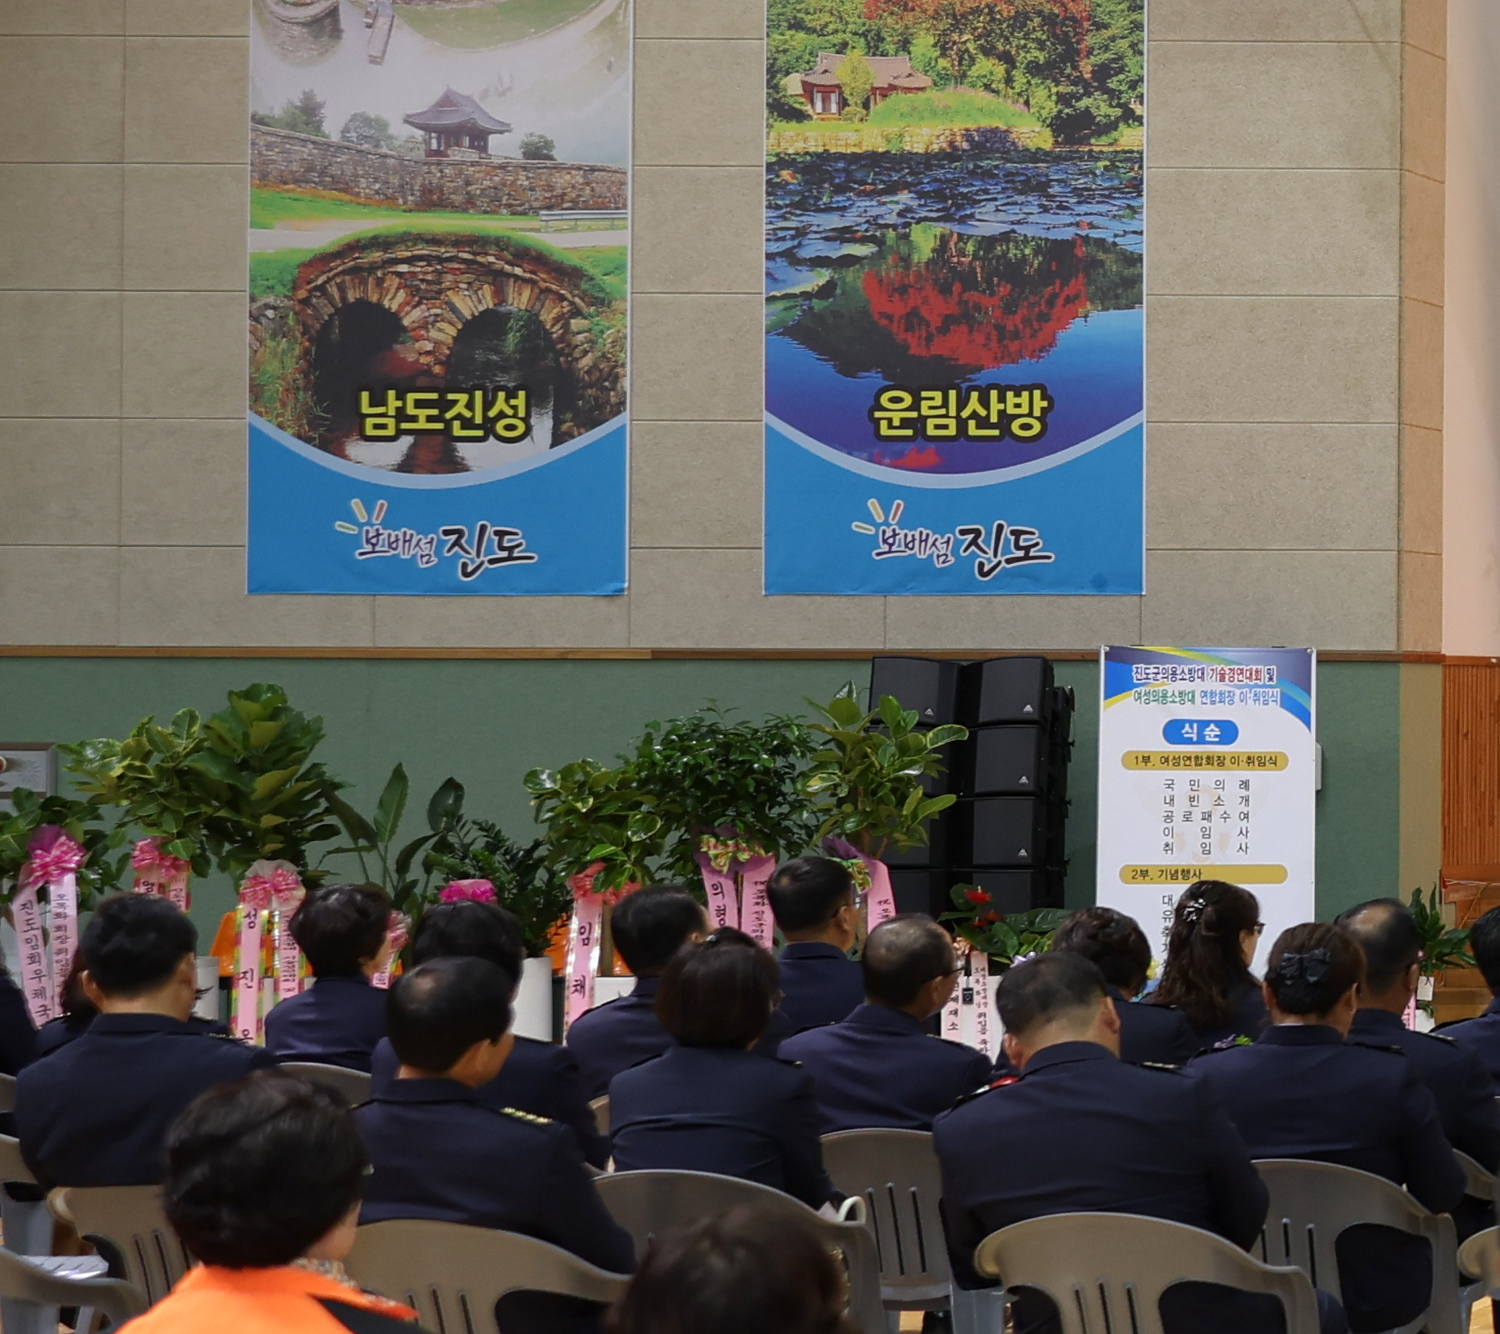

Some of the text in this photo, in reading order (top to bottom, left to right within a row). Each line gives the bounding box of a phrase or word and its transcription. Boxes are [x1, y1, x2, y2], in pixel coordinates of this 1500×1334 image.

[358, 389, 528, 439] 남도진성
[873, 390, 1048, 440] 운림산방
[442, 524, 536, 579] 진도
[959, 523, 1053, 578] 진도
[1133, 666, 1205, 682] 진도군의용소방대
[1209, 667, 1262, 683] 기술경연대회
[1134, 689, 1195, 705] 여성의용소방대
[1200, 689, 1235, 705] 연합회장
[1160, 755, 1226, 768] 여성연합회장
[1158, 868, 1202, 881] 기념행사
